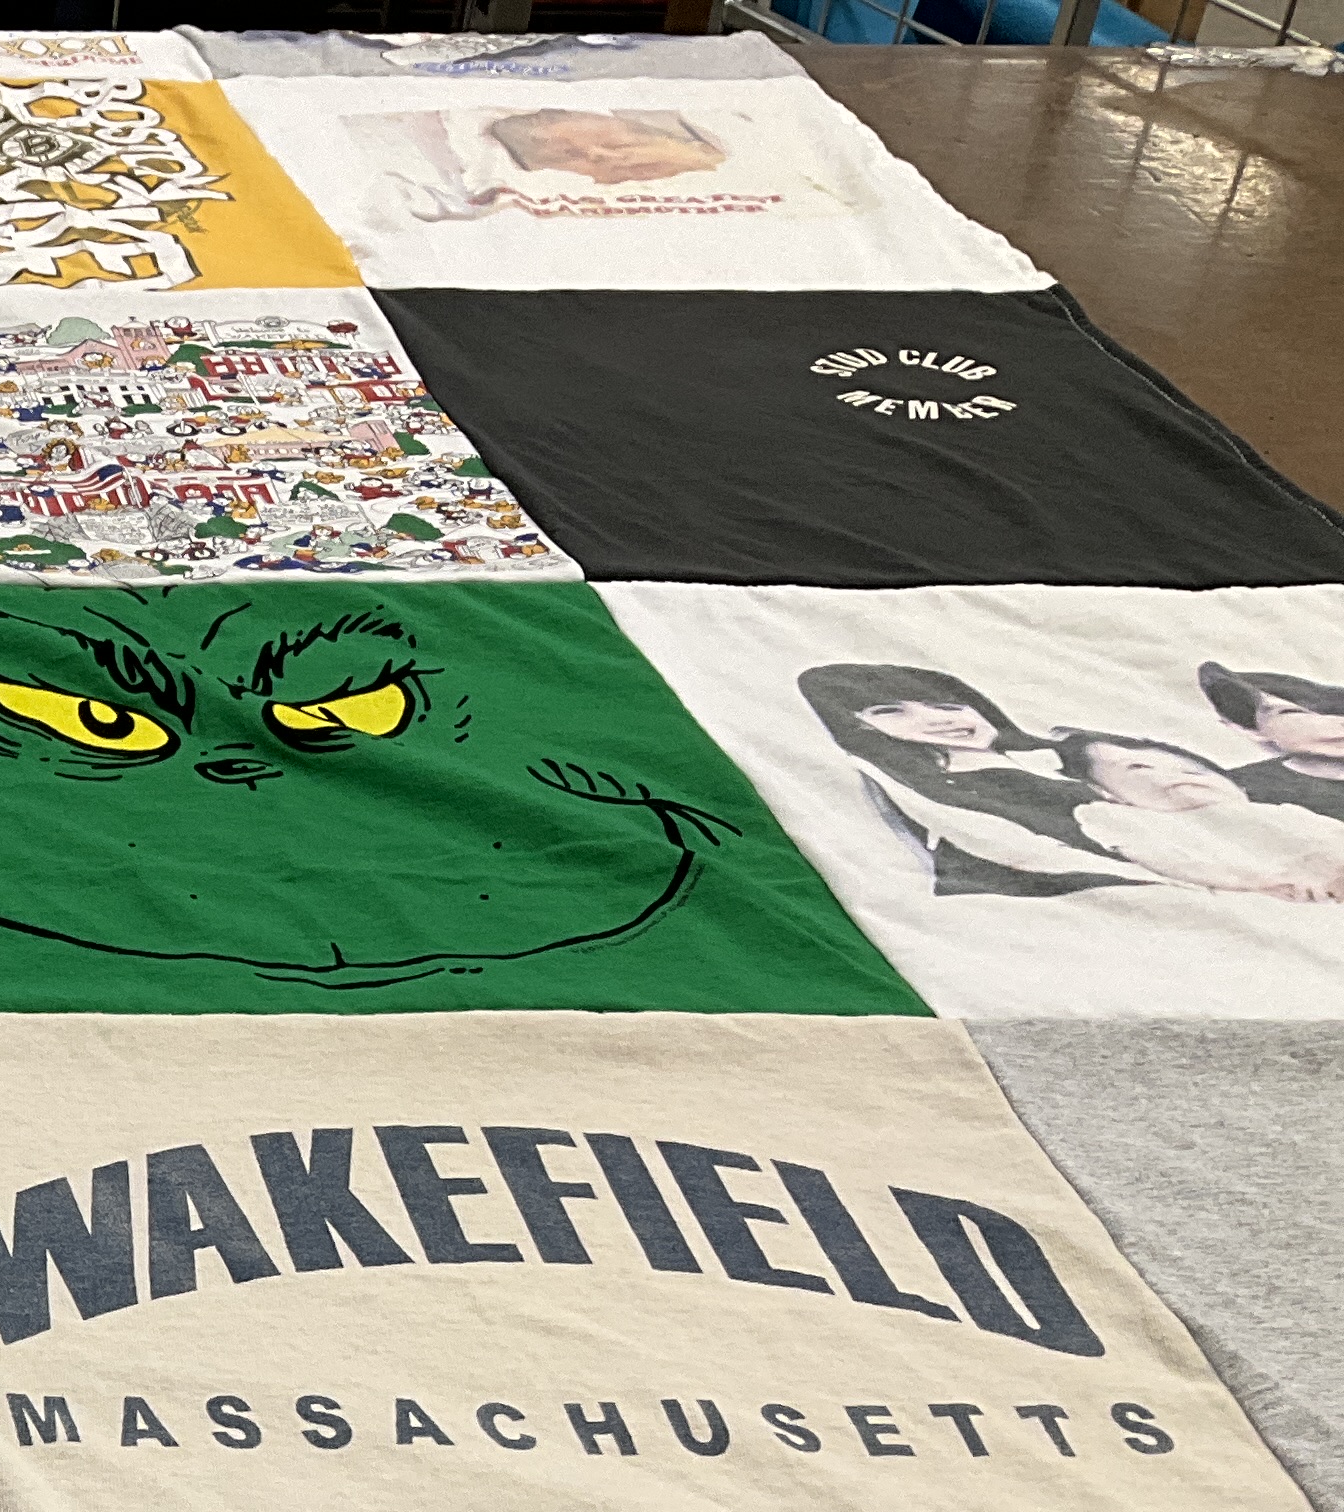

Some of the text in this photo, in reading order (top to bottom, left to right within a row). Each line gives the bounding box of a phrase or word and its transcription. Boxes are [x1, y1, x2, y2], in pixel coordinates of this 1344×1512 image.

[809, 348, 998, 381] STUD CLUB
[835, 390, 1018, 420] MEMBER
[4, 1390, 1178, 1458] MASSACHUSETTS
